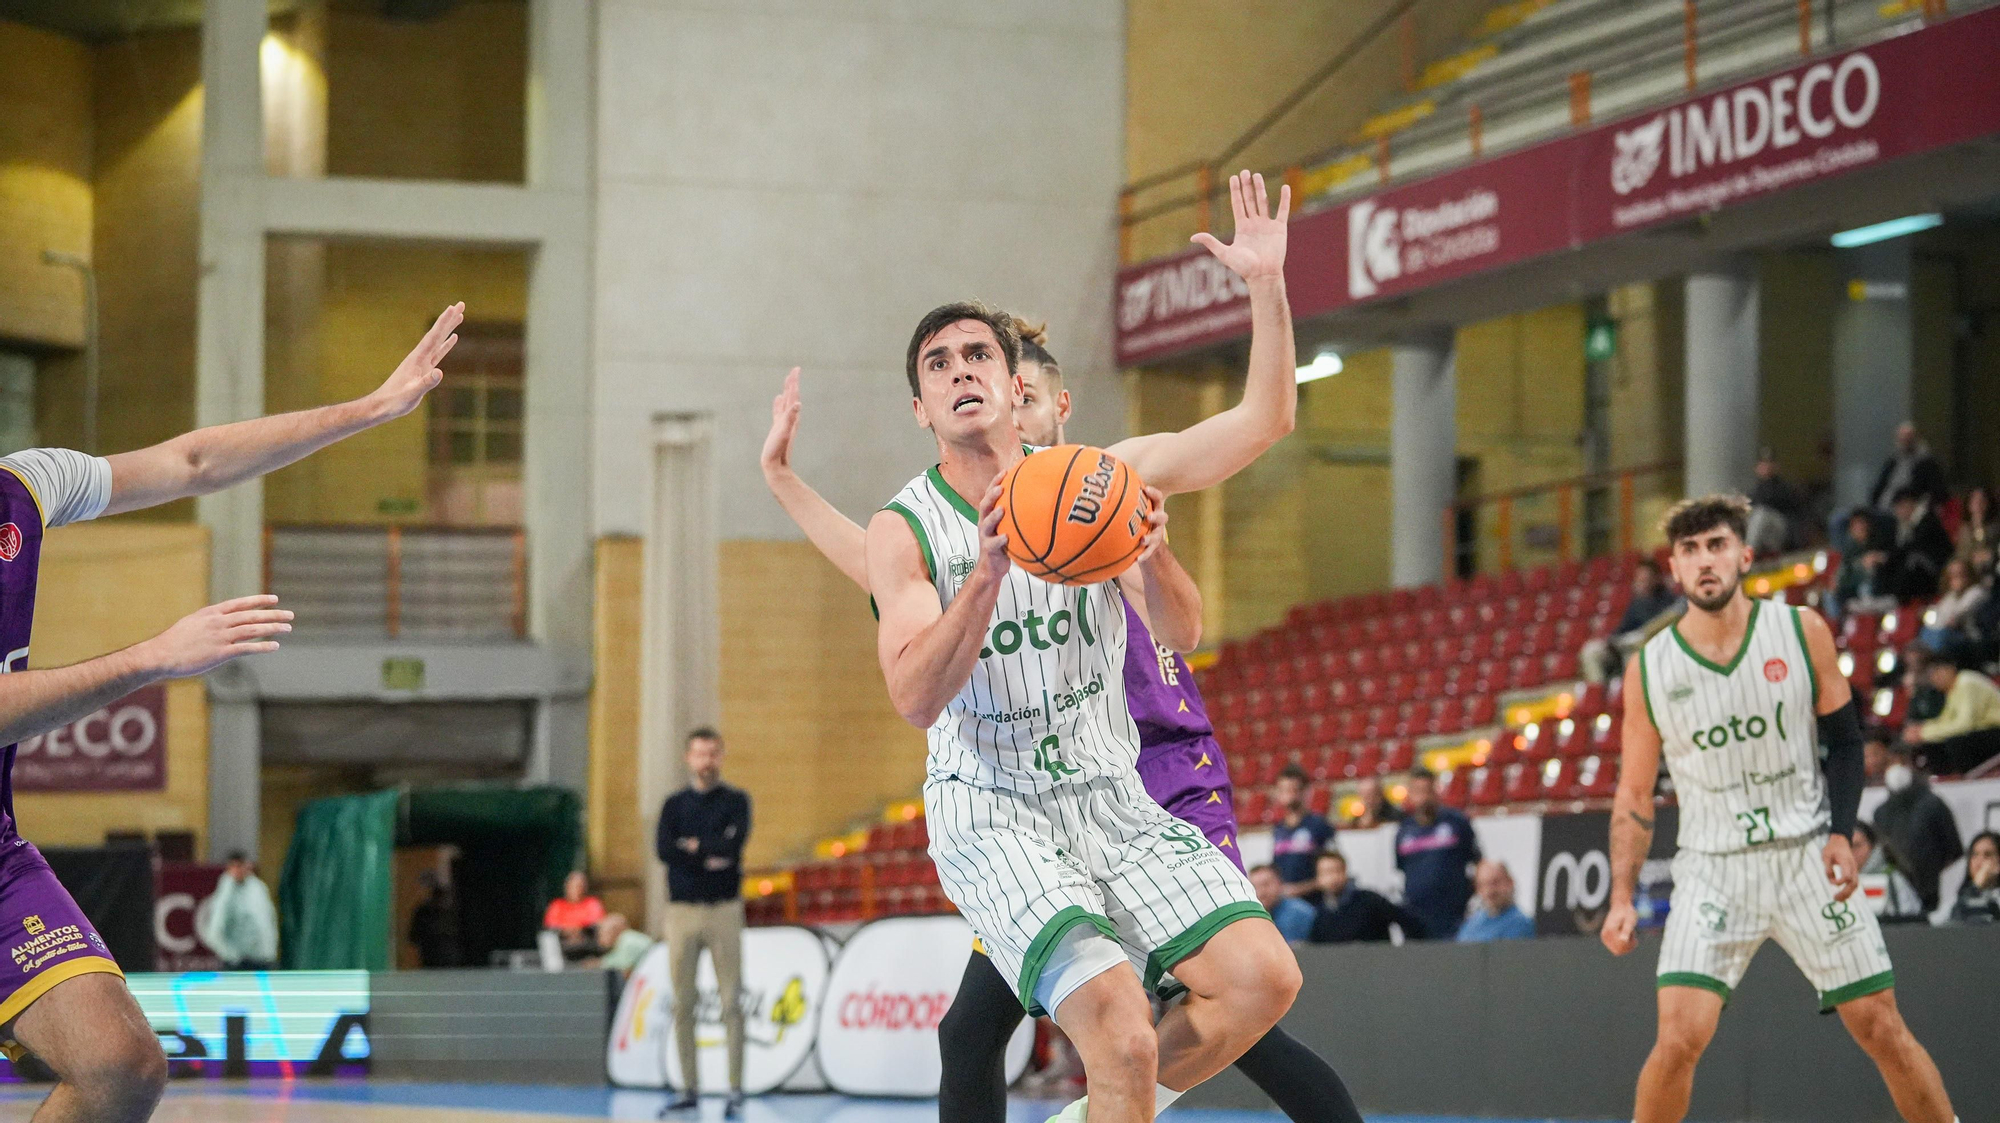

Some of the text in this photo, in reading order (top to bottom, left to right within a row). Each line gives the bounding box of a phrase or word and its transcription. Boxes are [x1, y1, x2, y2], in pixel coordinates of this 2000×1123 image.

[1668, 52, 1881, 178] IMDECO
[1053, 673, 1104, 713] Cajasol
[1692, 714, 1768, 751] coto
[1736, 806, 1775, 845] 27
[11, 924, 80, 959] ALIMENTOS
[14, 932, 84, 965] DE VALLADOLID
[838, 979, 949, 1030] CÓRDOB
